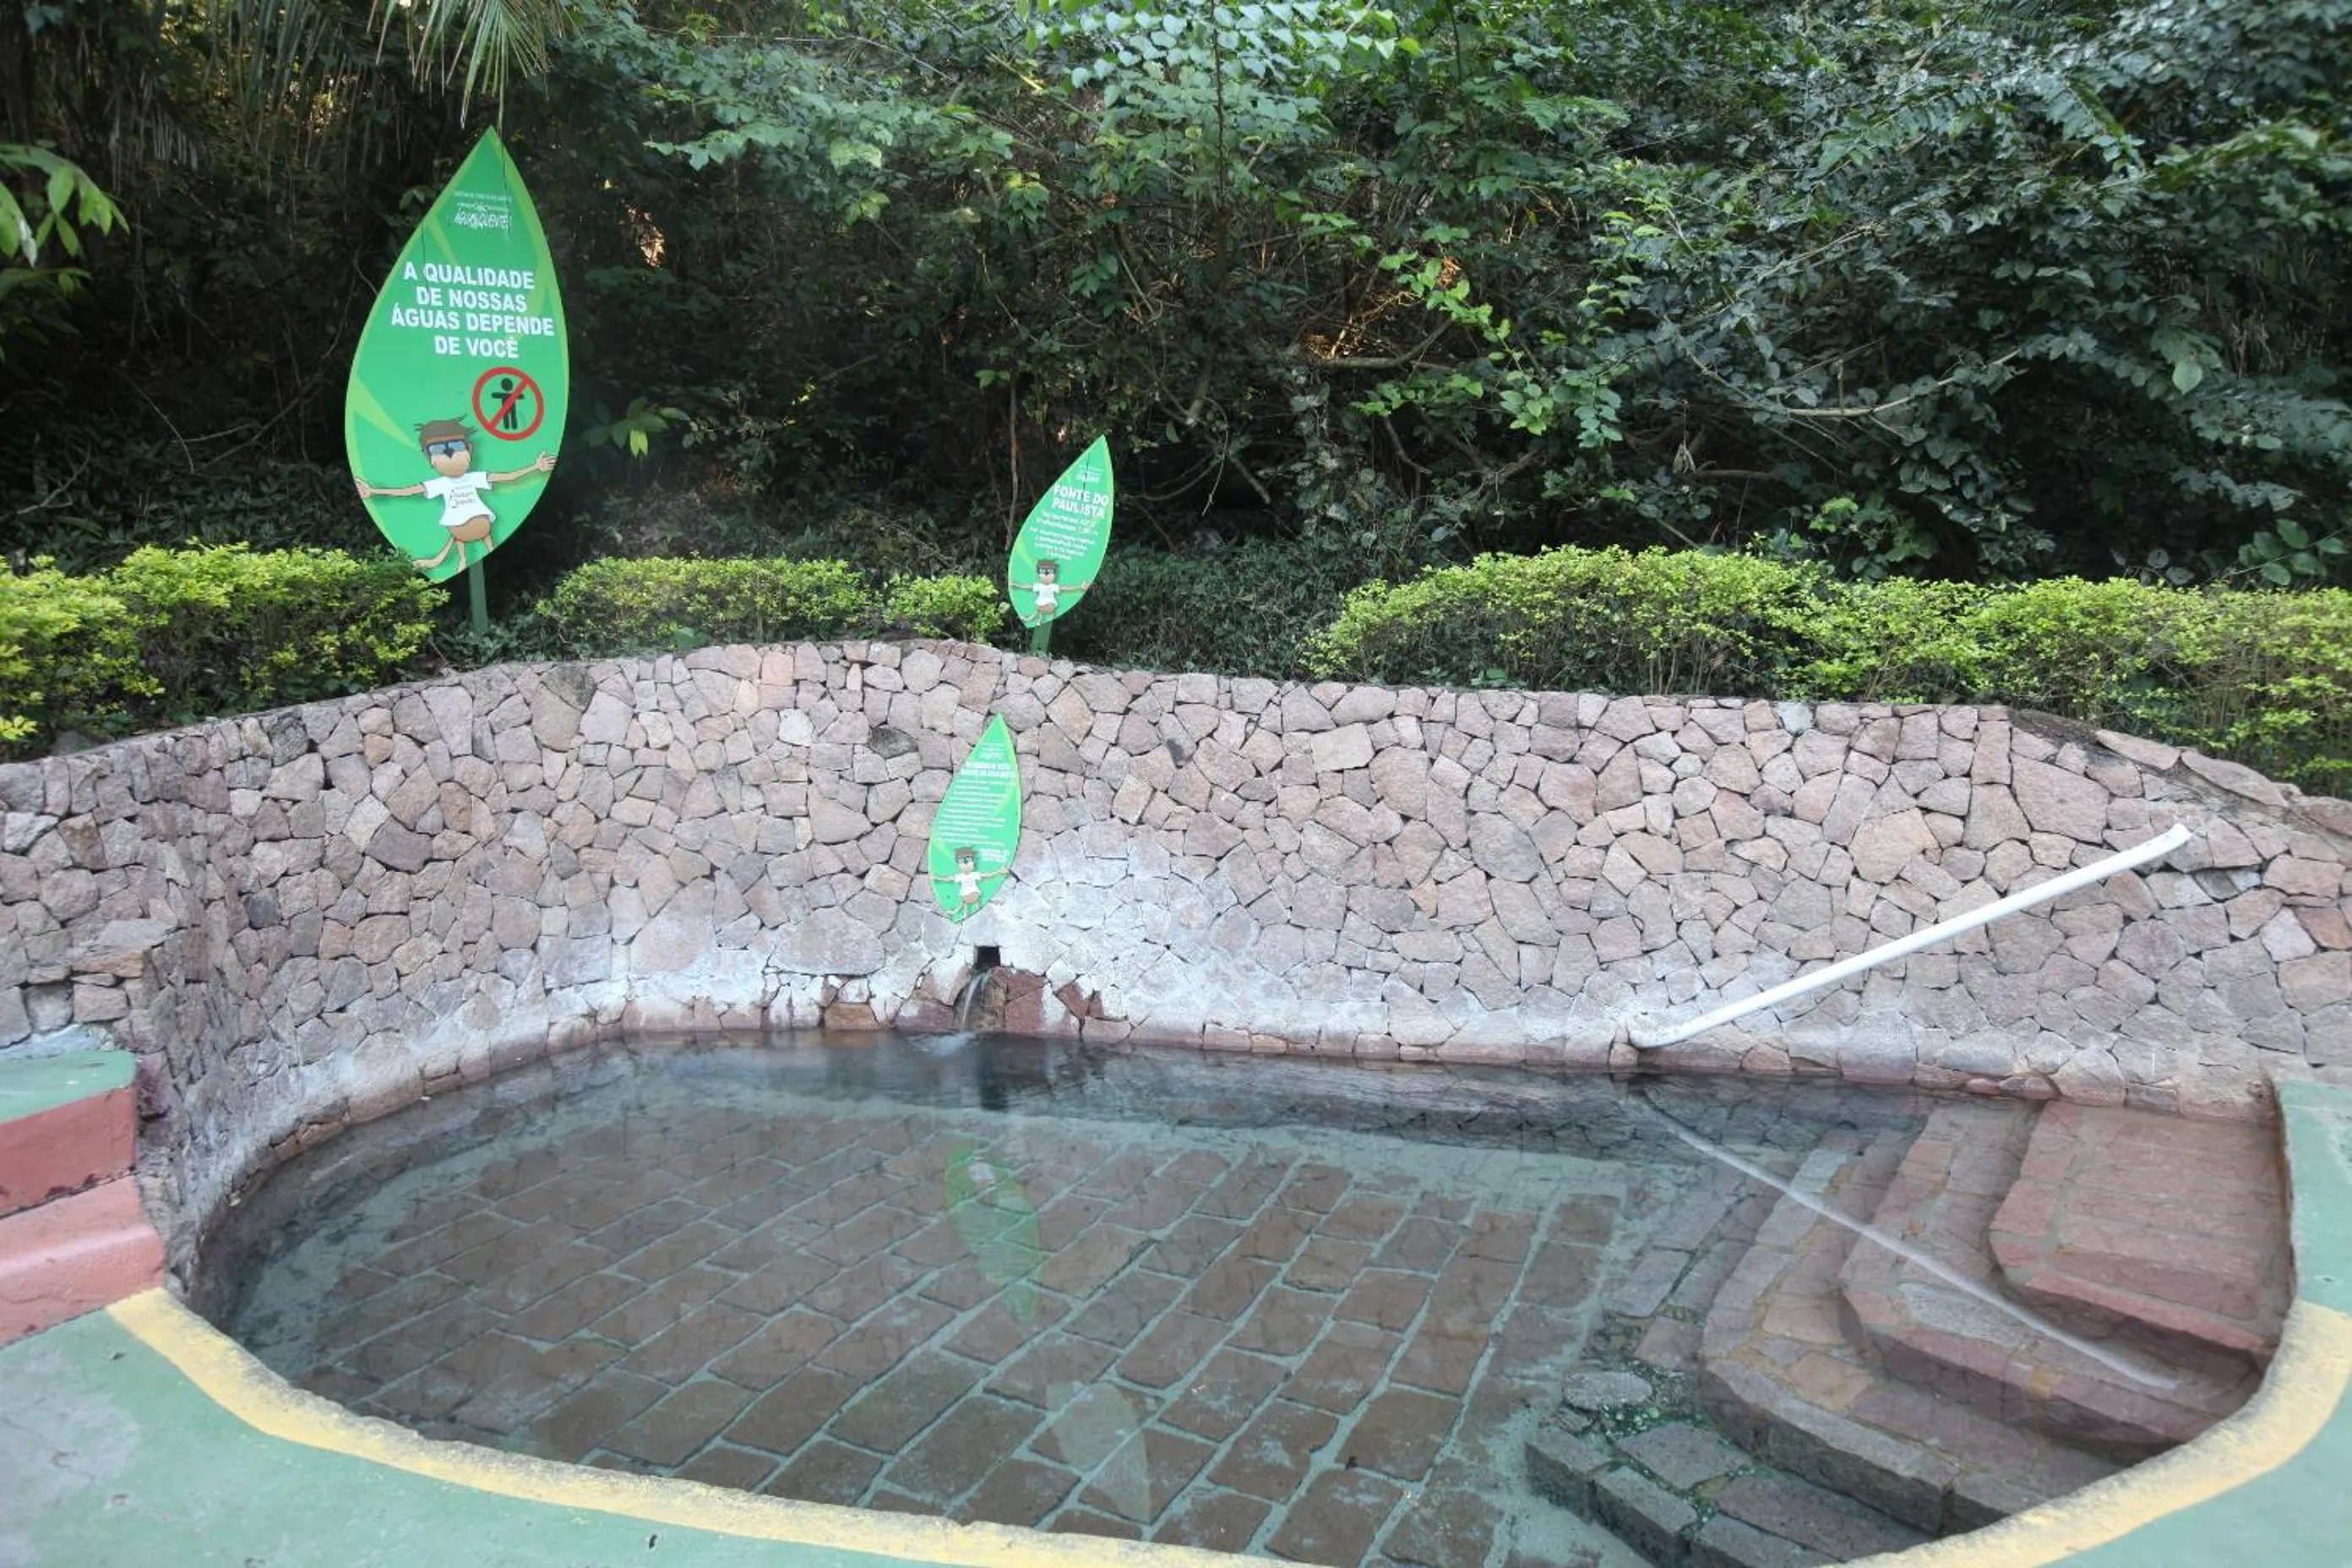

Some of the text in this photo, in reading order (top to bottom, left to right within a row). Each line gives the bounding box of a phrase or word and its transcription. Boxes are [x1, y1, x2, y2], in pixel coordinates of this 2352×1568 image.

[403, 261, 535, 290] A QUALIDADE
[416, 286, 527, 313] DE NOSSAS
[391, 302, 554, 336] ÁGUAS DEPENDE
[435, 335, 519, 358] DE VOCÊ
[1051, 497, 1106, 519] PAULISTA
[1053, 484, 1109, 507] FONTE DO
